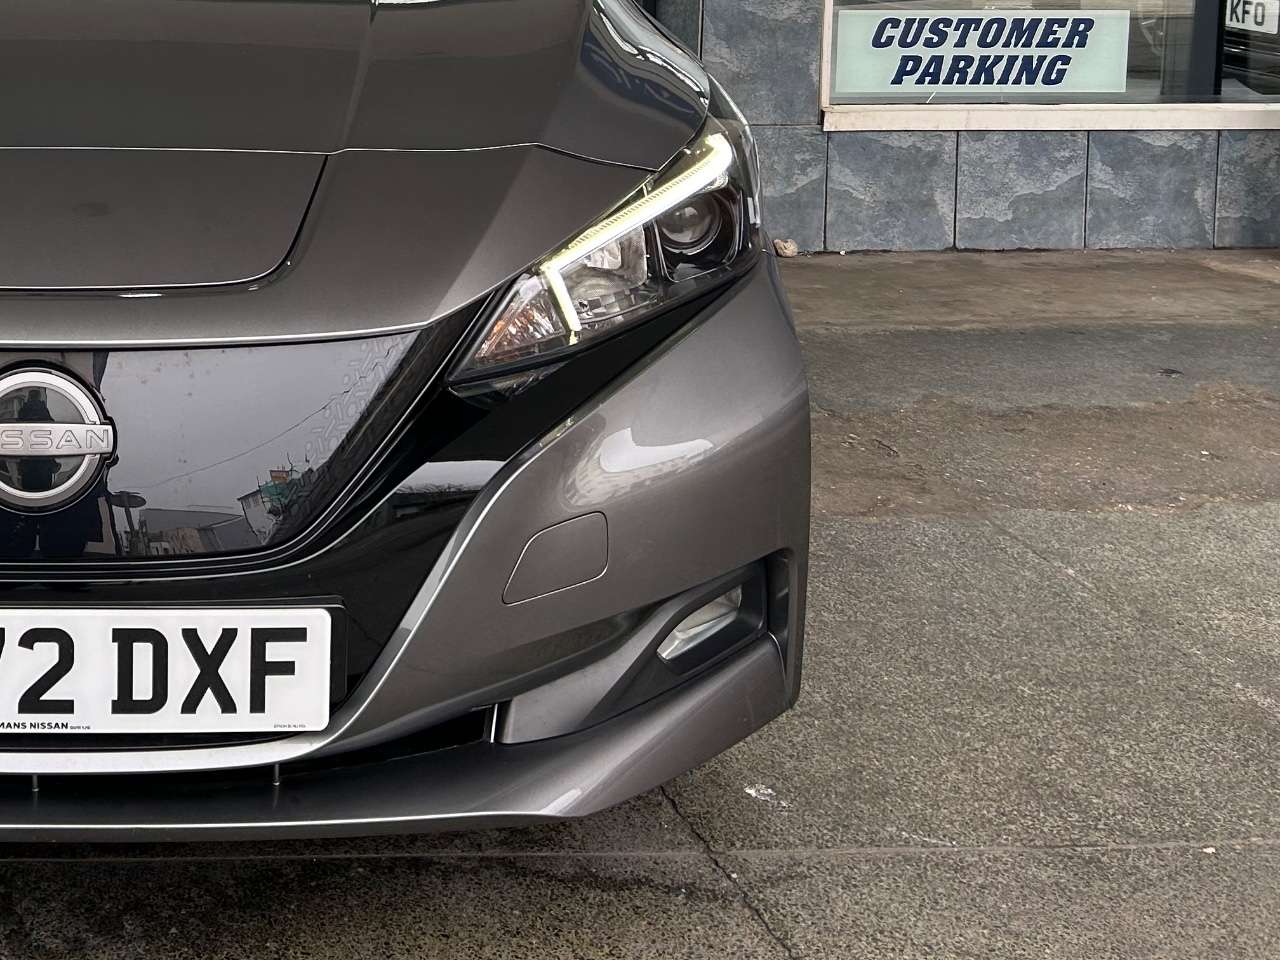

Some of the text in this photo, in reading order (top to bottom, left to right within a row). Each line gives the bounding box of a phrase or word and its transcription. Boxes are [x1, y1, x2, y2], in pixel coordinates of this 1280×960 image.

[871, 17, 1095, 49] CUSTOMER
[890, 54, 1072, 86] PARKING
[110, 627, 309, 716] DXF
[29, 722, 69, 730] NISSAN
